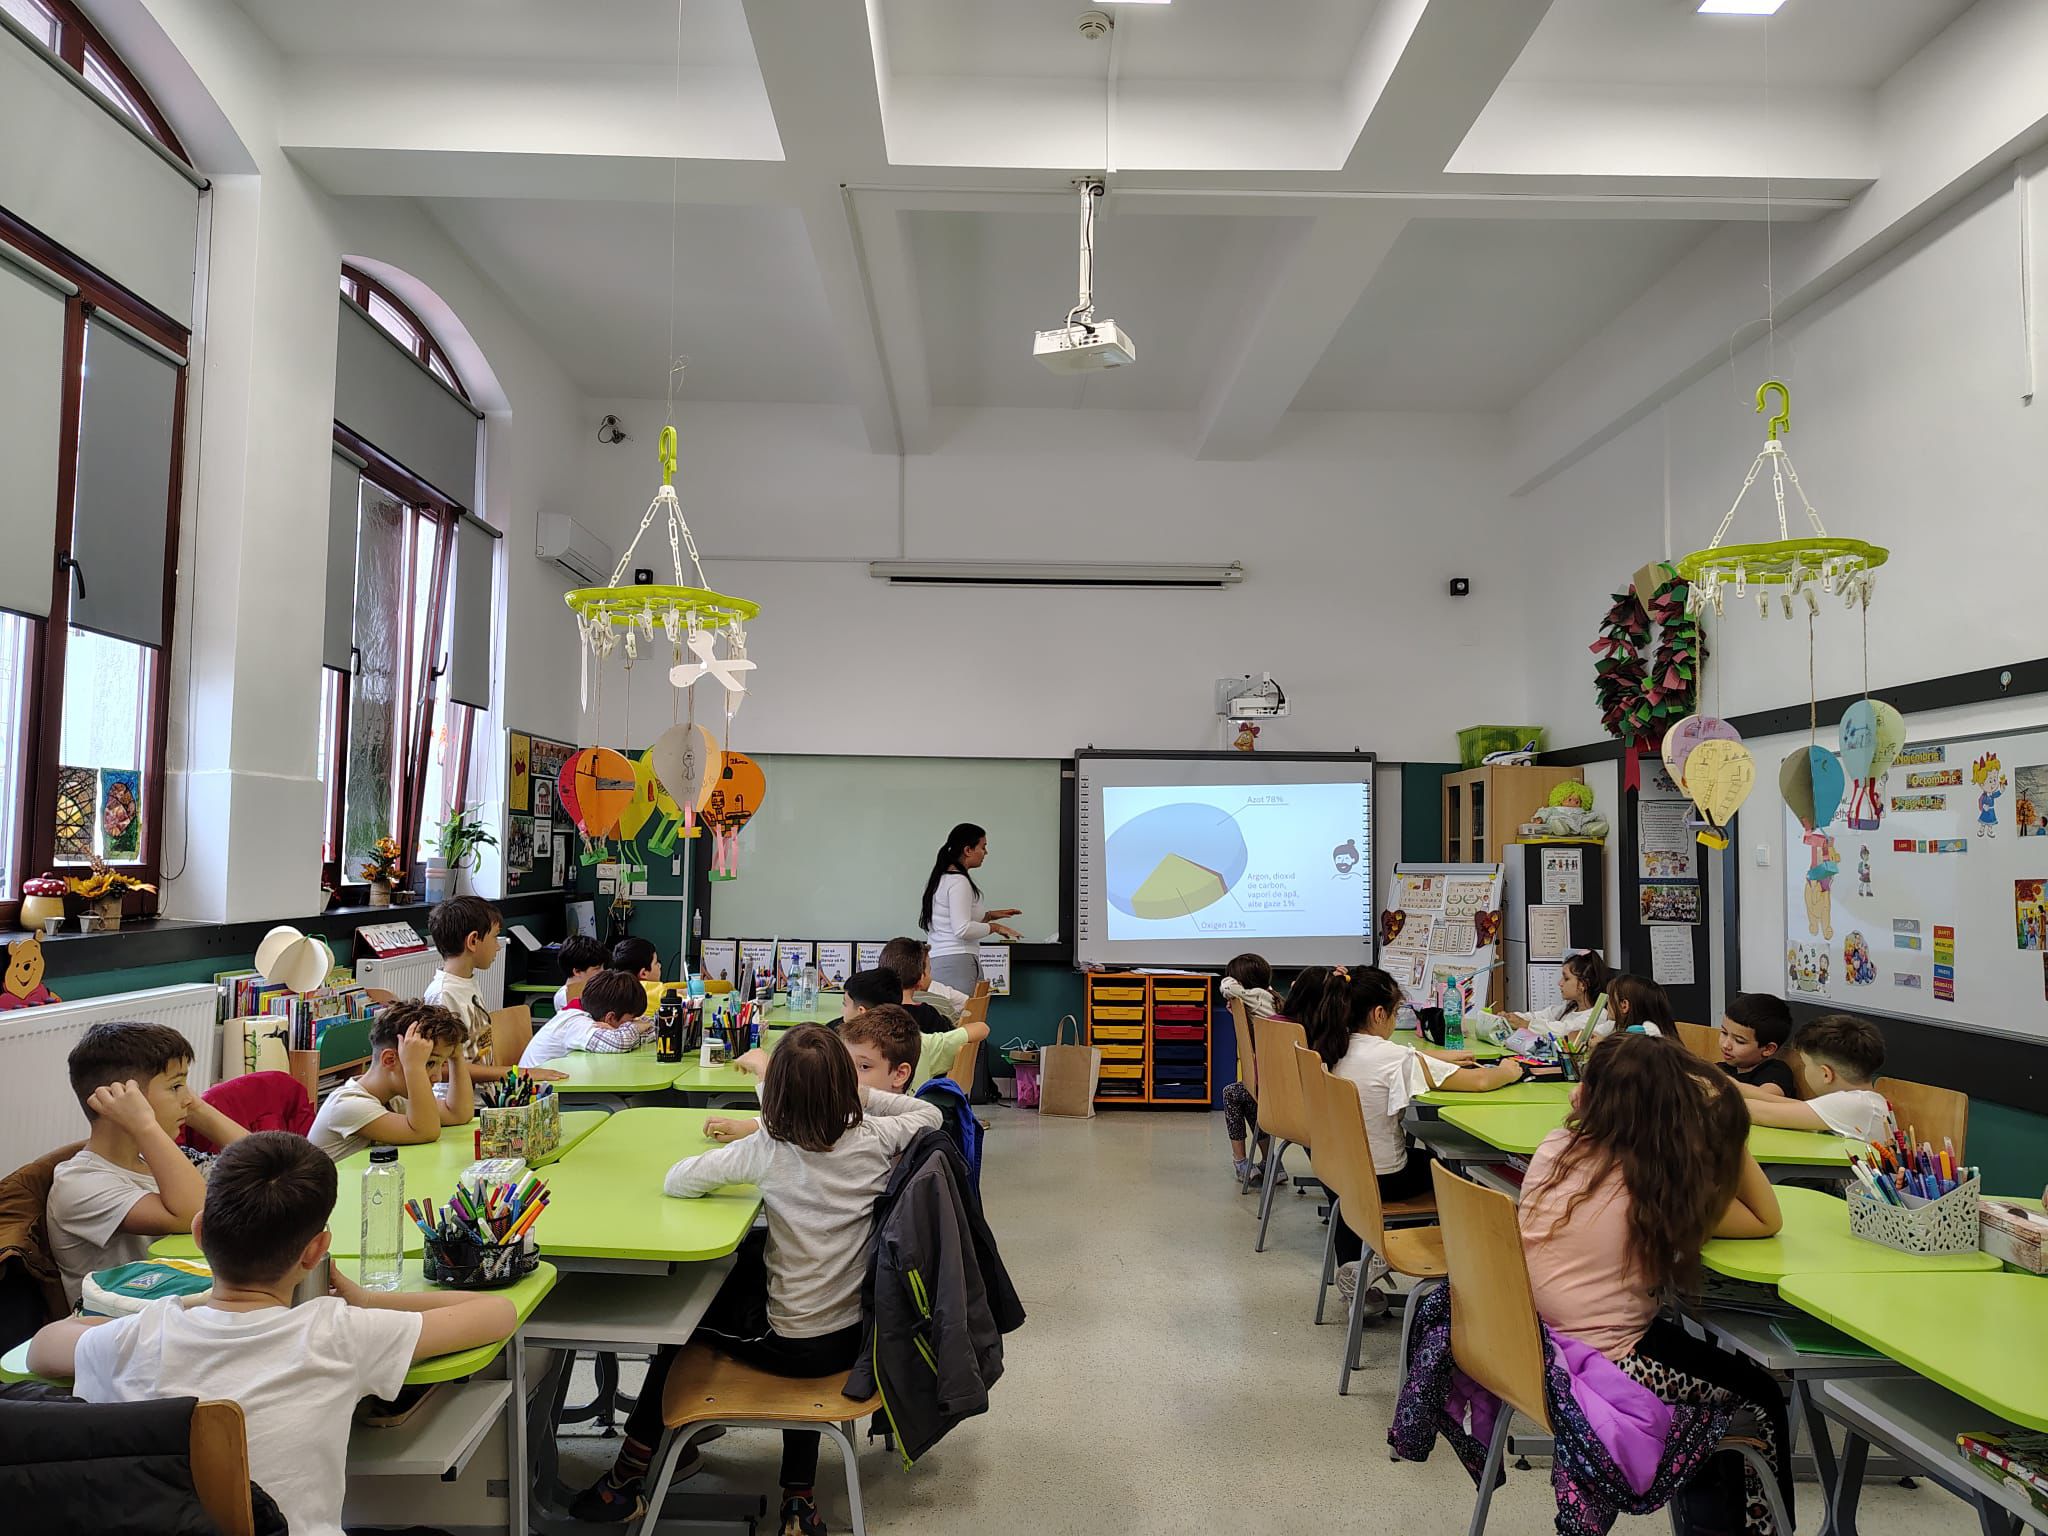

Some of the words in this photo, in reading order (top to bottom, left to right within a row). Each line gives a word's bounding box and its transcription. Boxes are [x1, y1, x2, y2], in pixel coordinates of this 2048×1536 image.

[1247, 796, 1264, 804] Azot
[1247, 873, 1272, 882] Argon,
[1272, 872, 1296, 880] dioxid
[1200, 920, 1226, 930] Oxigen
[1228, 920, 1246, 928] 21%
